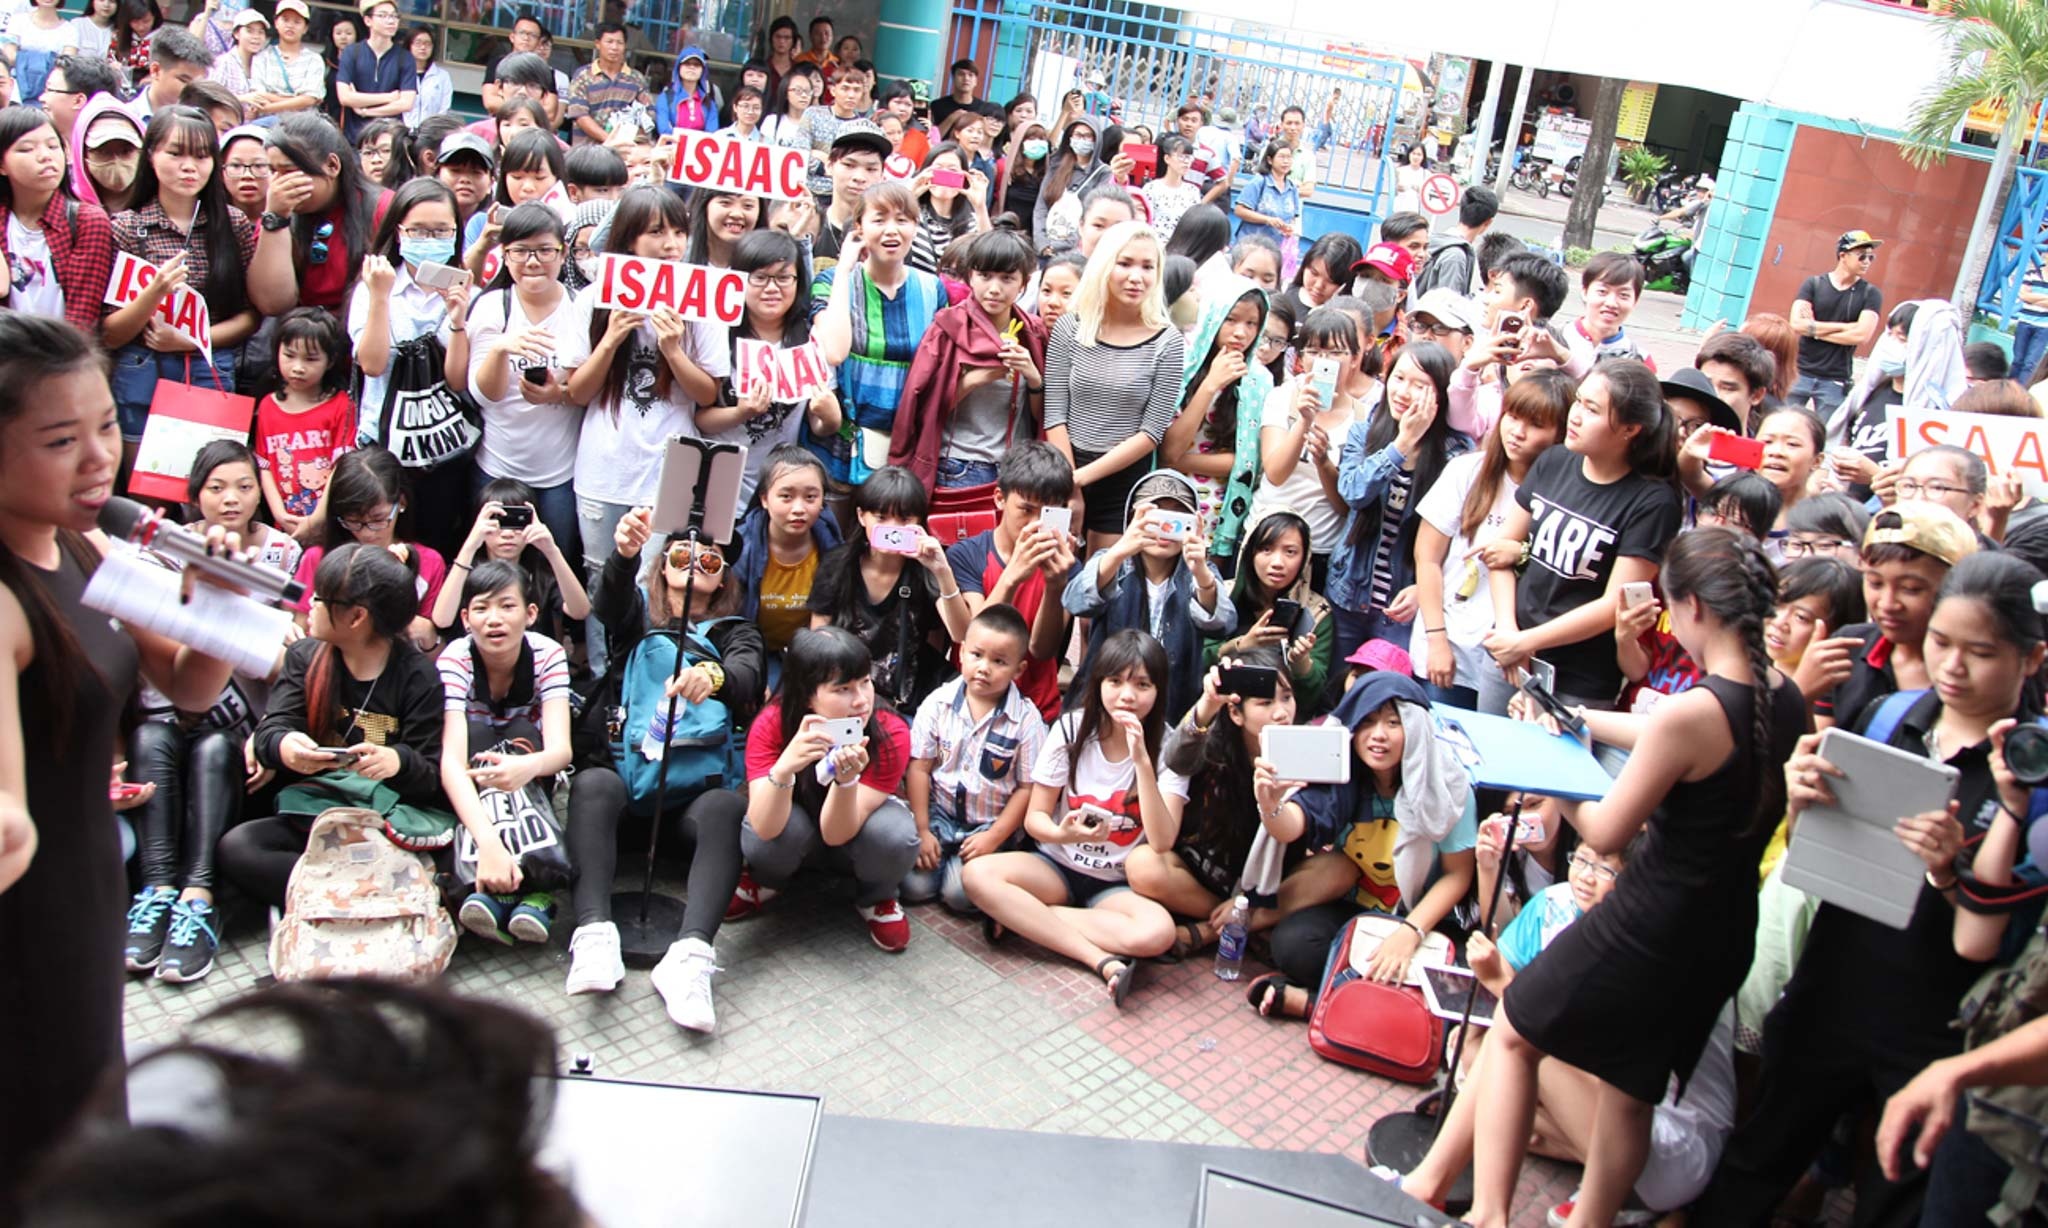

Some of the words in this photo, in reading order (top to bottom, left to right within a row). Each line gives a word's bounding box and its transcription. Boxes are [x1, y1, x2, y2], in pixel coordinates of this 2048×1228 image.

[671, 134, 804, 198] ISAAC
[601, 256, 744, 322] ISAAC
[401, 436, 418, 460] A
